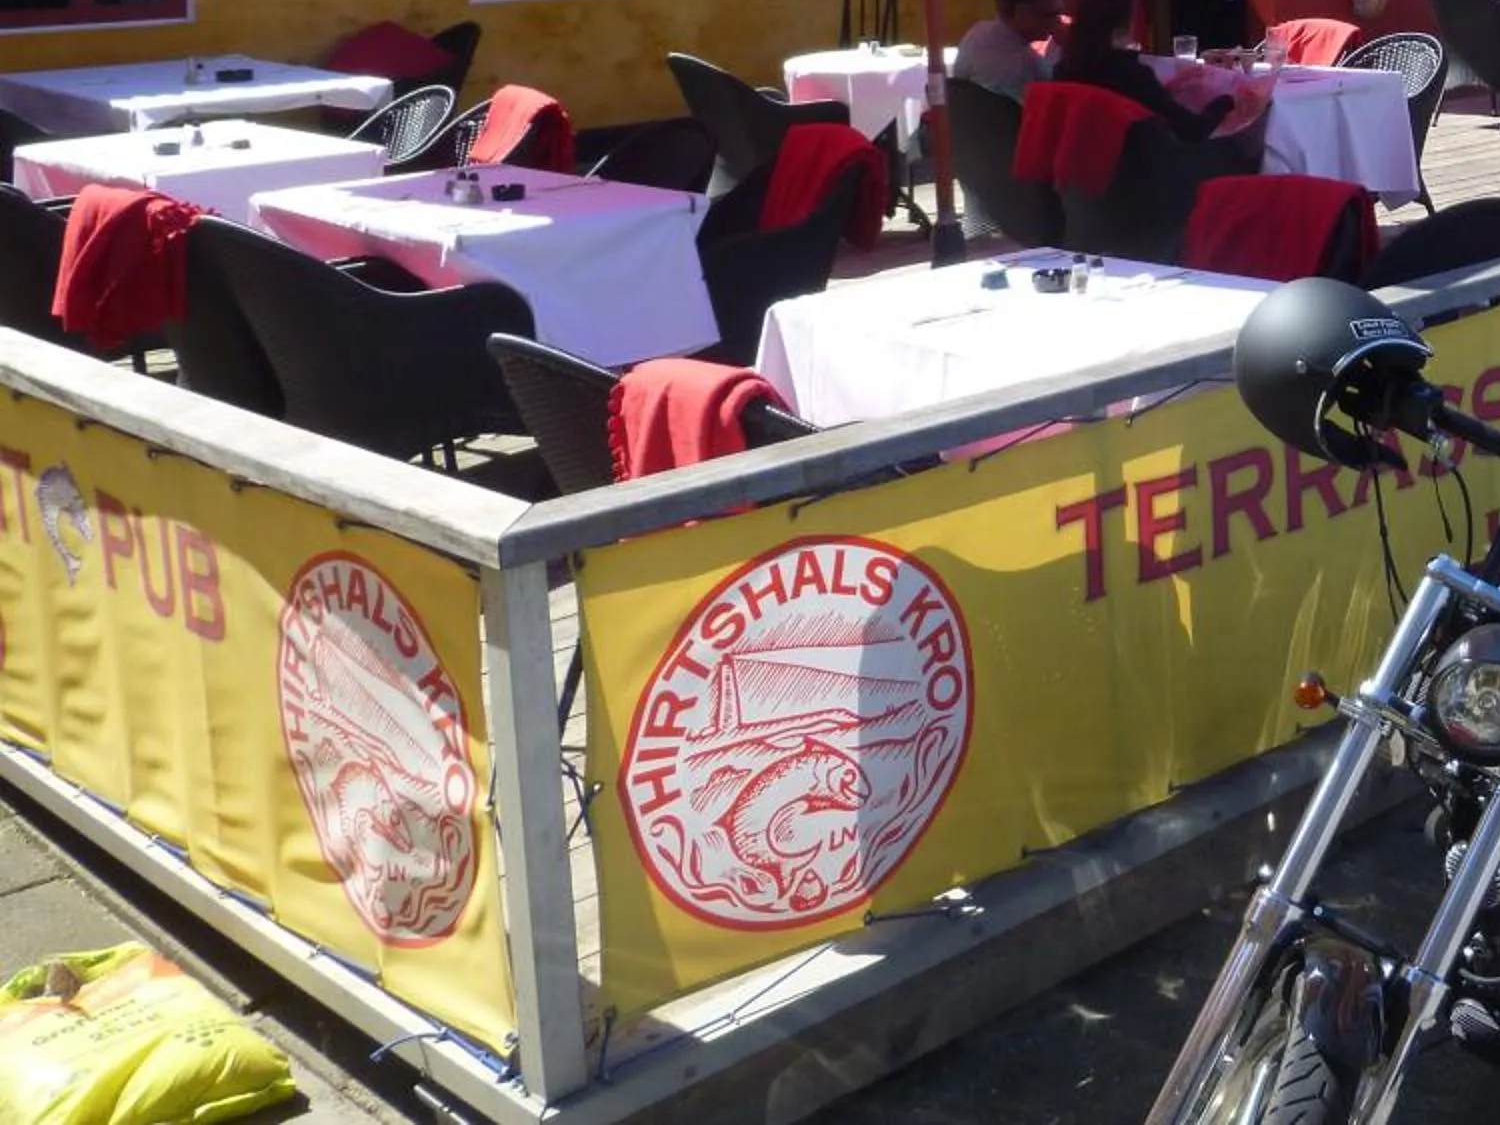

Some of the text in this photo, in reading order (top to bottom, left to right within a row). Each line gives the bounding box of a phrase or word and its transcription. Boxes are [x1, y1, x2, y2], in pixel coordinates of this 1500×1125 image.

[94, 487, 226, 643] PUB
[632, 549, 964, 819] HIRTSHALS KRO
